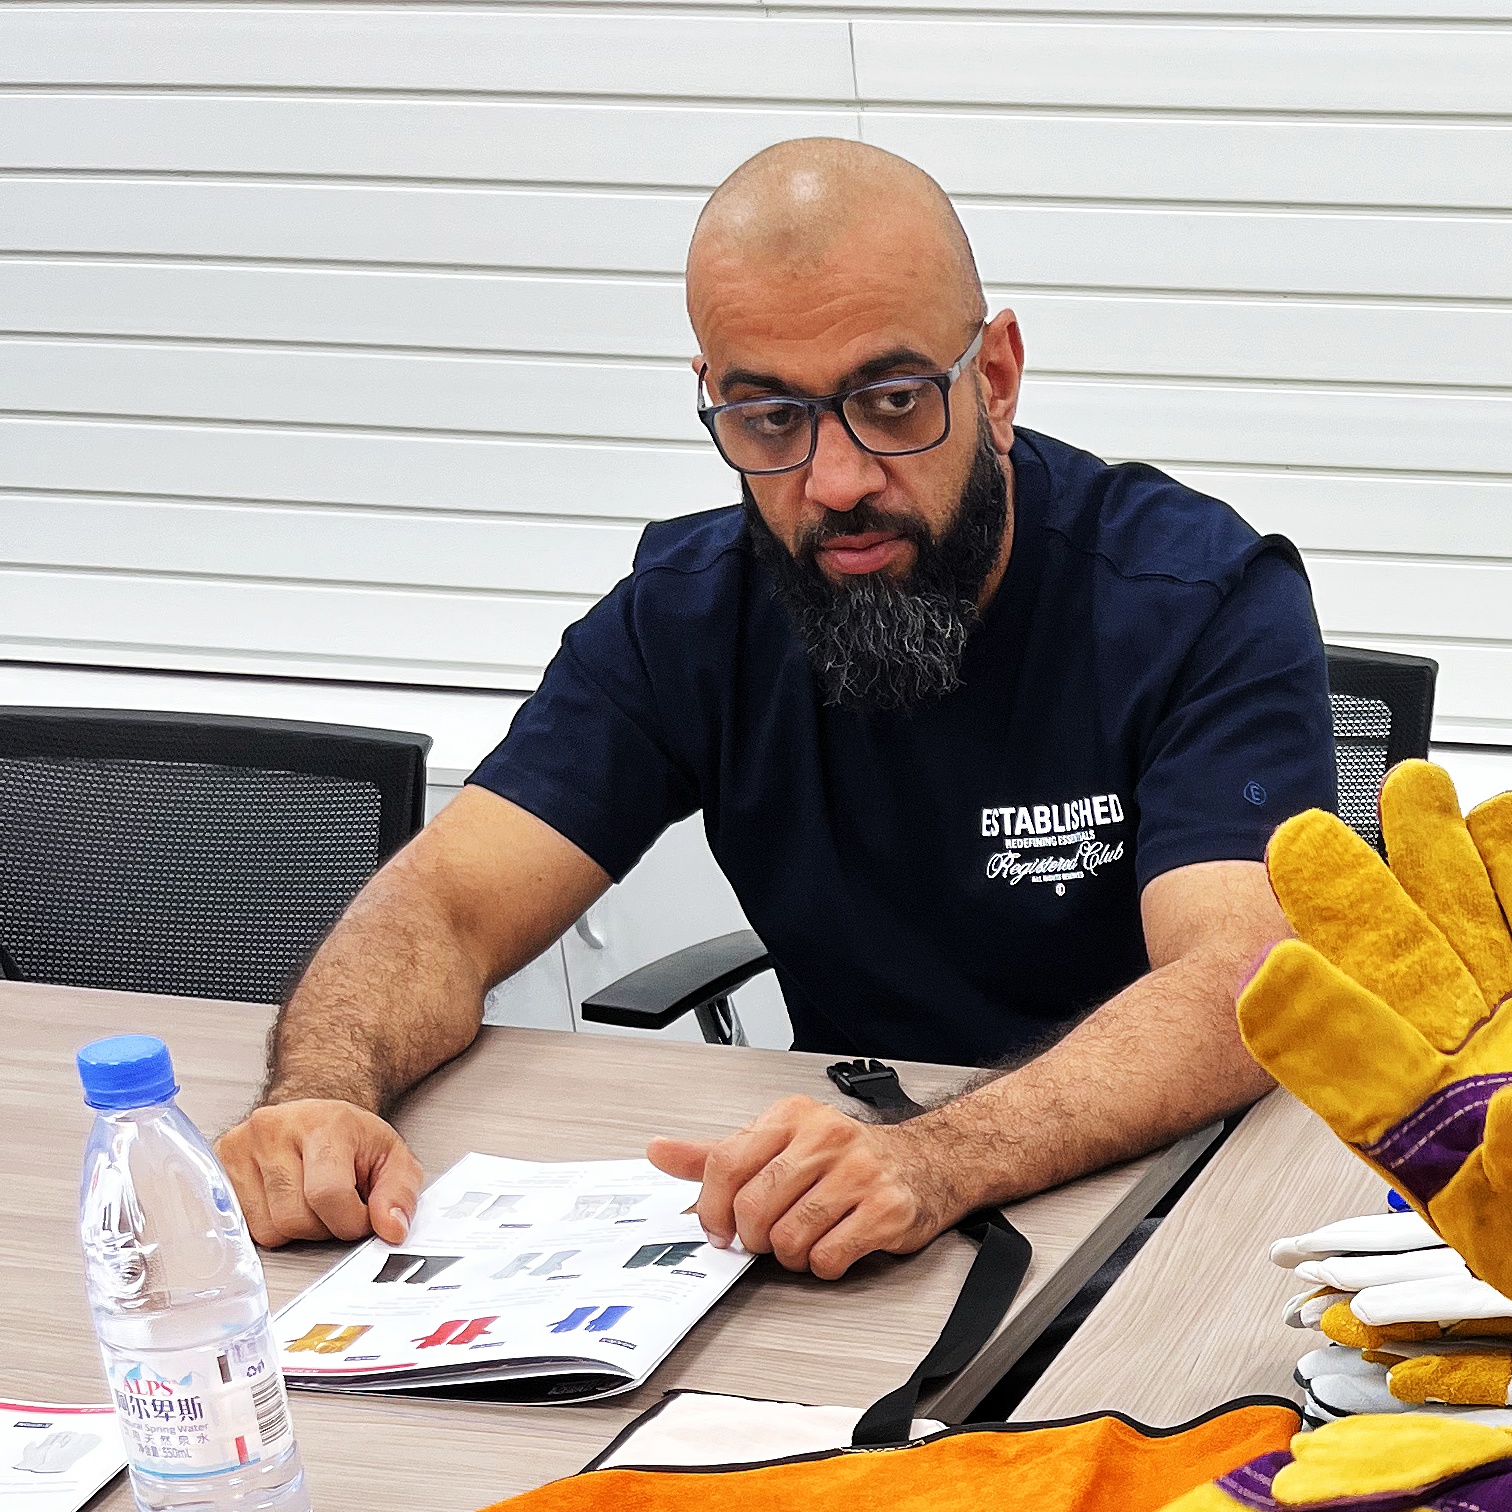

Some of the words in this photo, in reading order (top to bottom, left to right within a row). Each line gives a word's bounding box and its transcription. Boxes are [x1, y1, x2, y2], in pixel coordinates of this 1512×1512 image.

[981, 794, 1125, 837] ESTABLISHED
[986, 849, 1079, 885] Registered
[1077, 840, 1124, 876] Club
[123, 1377, 174, 1397] ALPS
